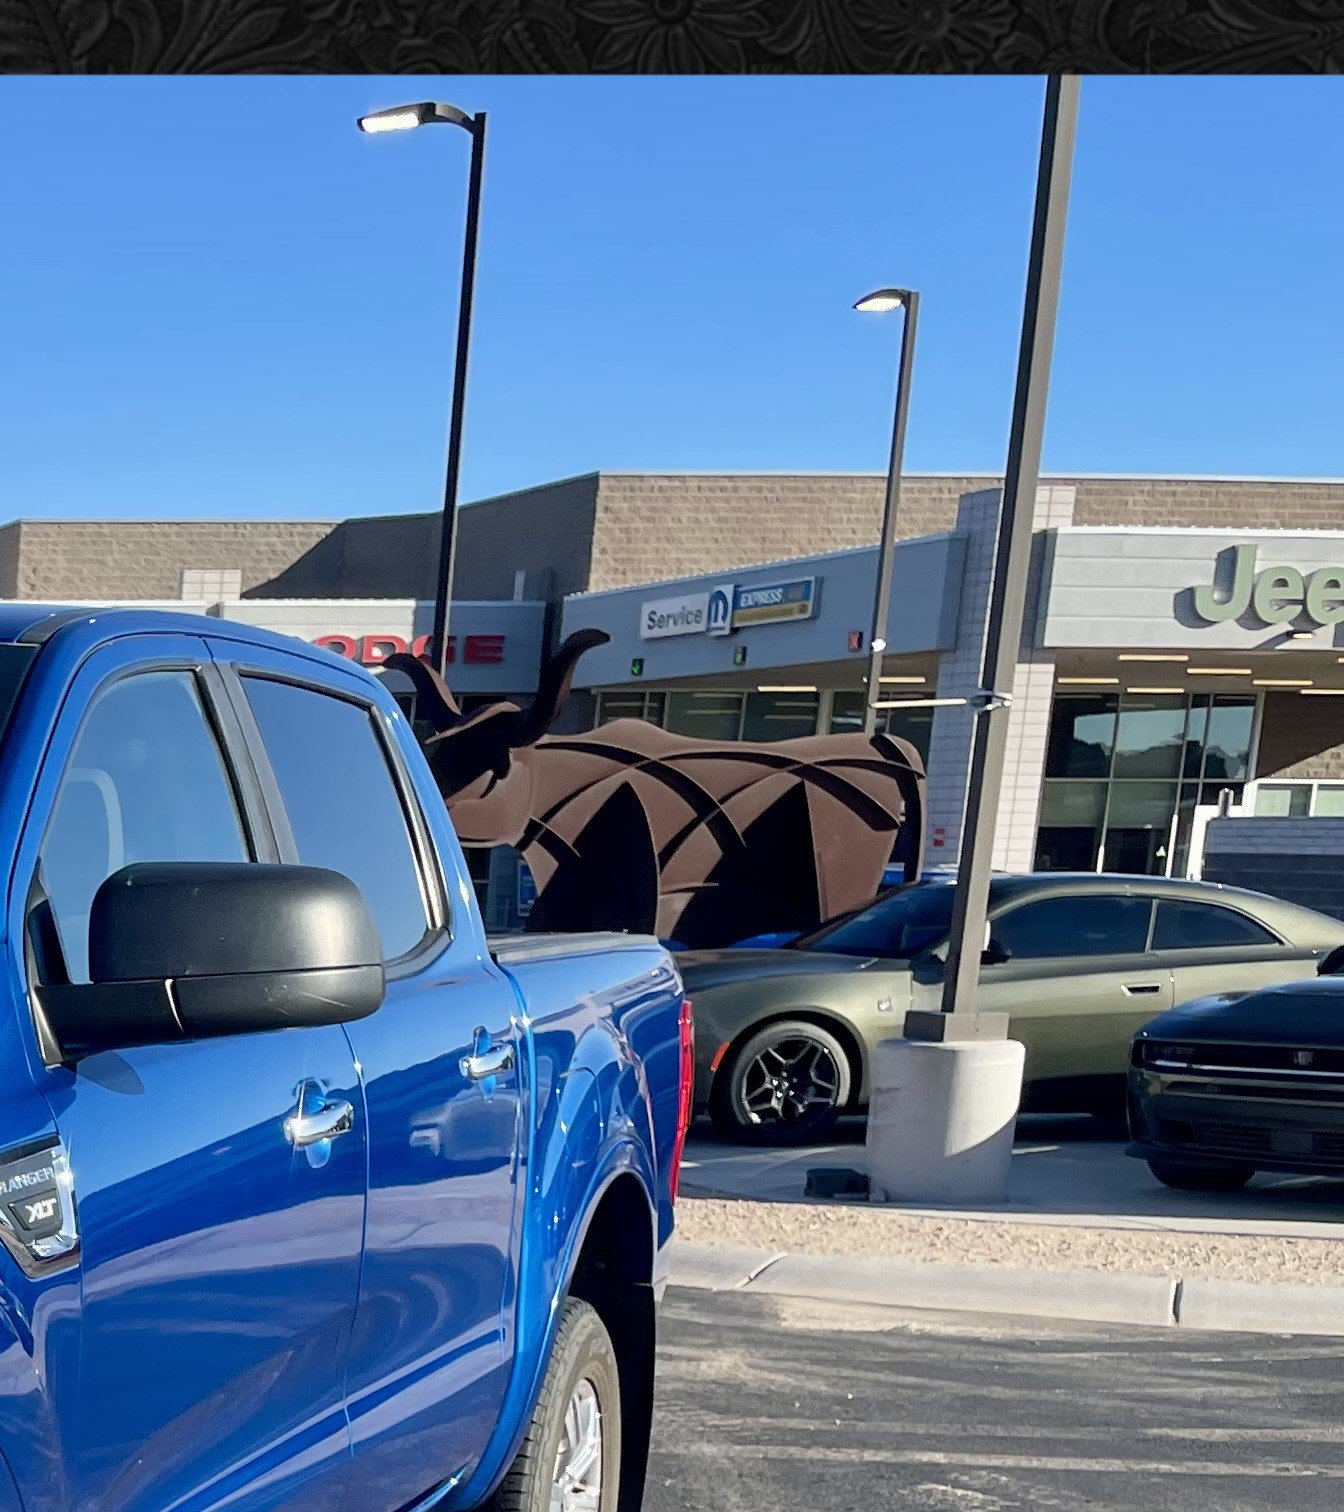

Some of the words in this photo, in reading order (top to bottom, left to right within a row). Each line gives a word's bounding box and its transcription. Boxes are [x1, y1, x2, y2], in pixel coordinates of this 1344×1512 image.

[1195, 544, 1344, 625] Jee
[647, 606, 703, 630] Service
[314, 634, 506, 665] ODGE
[24, 1197, 57, 1223] XLT
